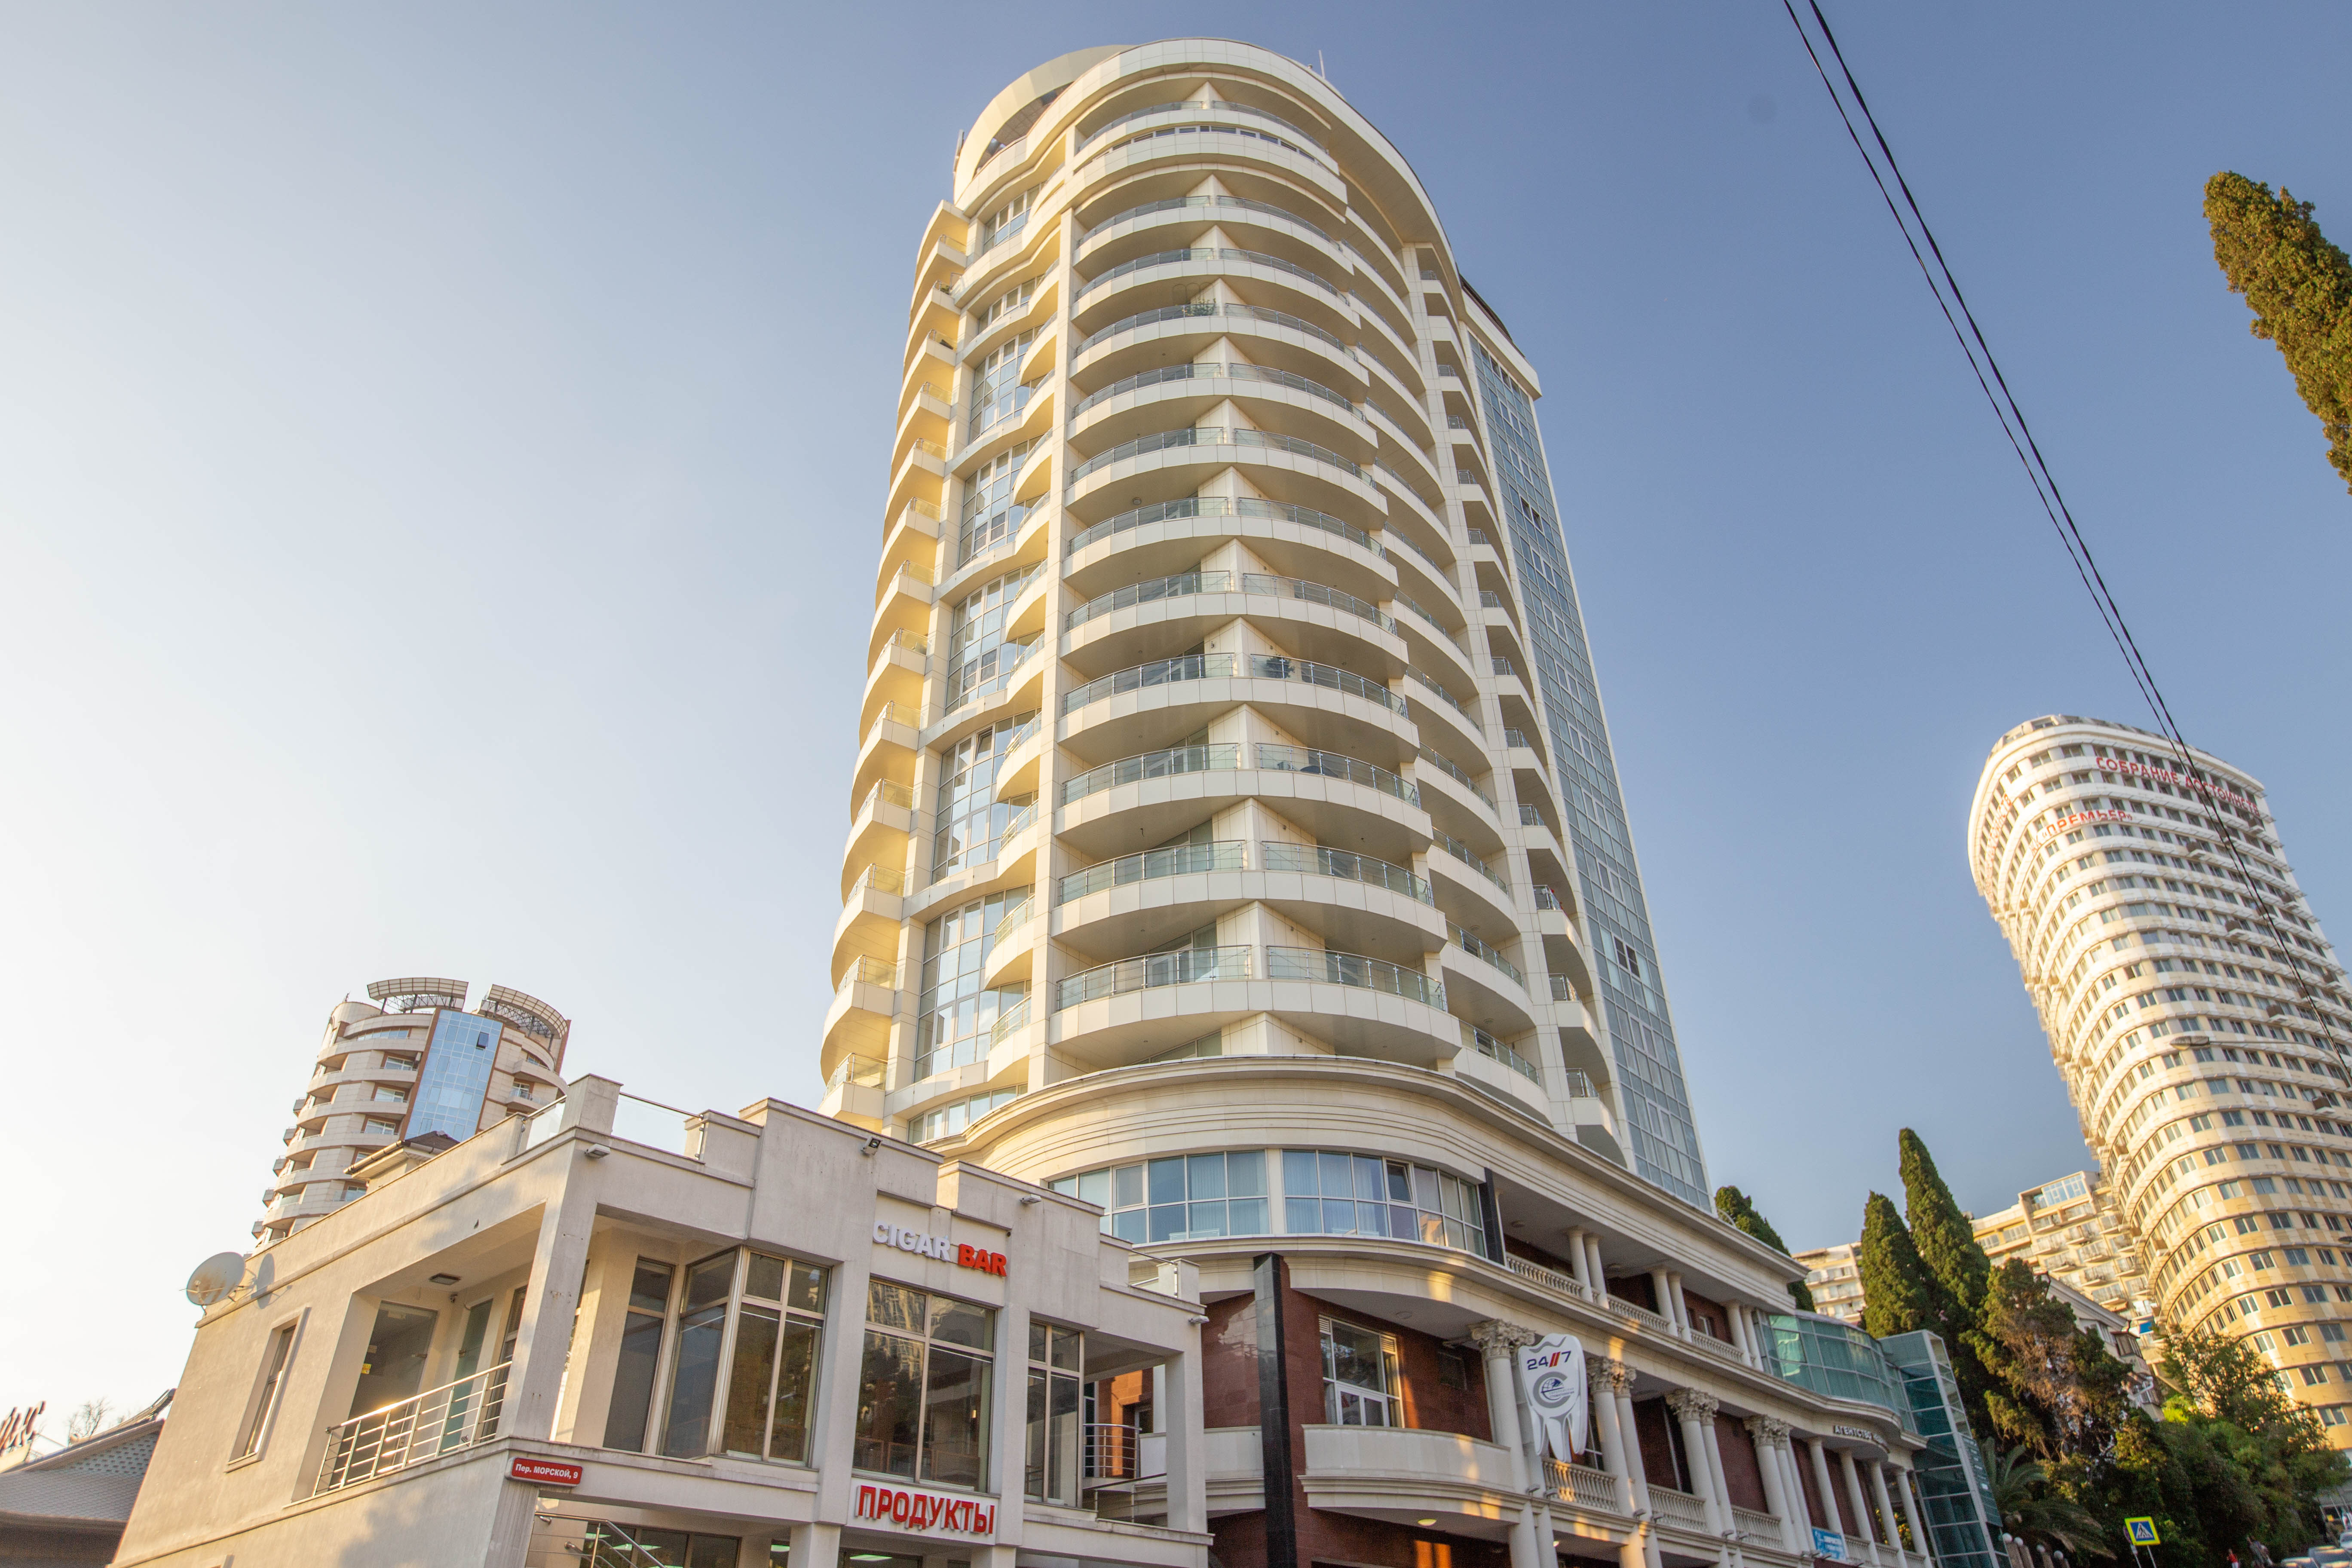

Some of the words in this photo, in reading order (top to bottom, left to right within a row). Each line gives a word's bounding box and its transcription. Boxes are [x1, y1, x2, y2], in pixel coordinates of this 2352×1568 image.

[2096, 756, 2180, 785] СОБРАНИЕ
[873, 1220, 951, 1262] CIGAR
[958, 1243, 1007, 1277] BAR
[515, 1464, 532, 1473] Пер.
[533, 1466, 572, 1479] МОРСКОЙ,
[855, 1485, 995, 1534] ПРОДУКТЫ
